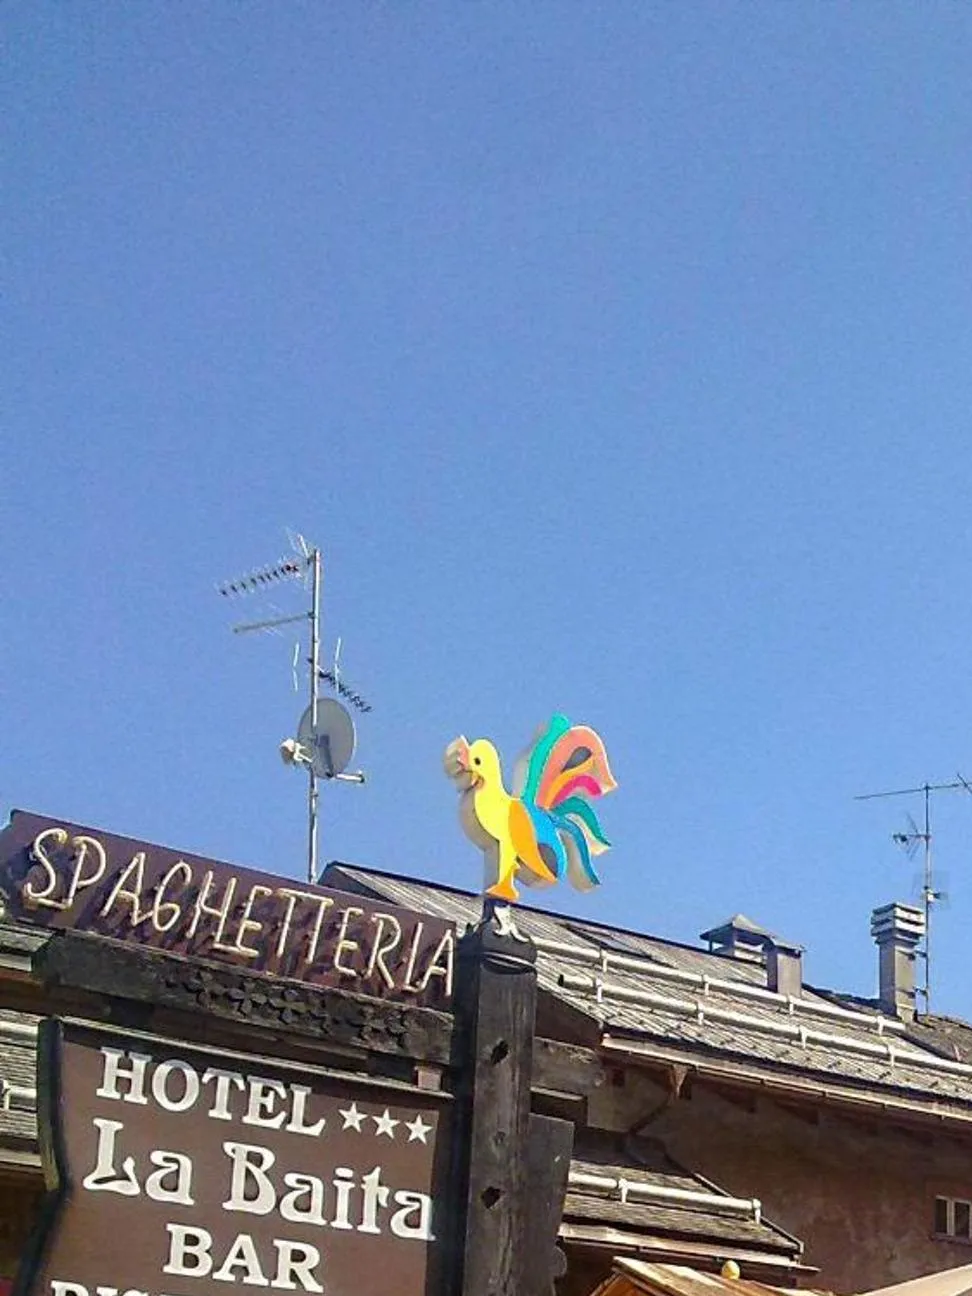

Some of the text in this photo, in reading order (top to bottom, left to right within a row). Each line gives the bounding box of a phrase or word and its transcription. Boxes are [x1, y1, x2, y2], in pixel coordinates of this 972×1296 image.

[24, 828, 457, 997] SPAGHETTERIA
[96, 1047, 326, 1137] HOTEL
[82, 1118, 437, 1241] La Baita
[163, 1223, 324, 1293] BAR
